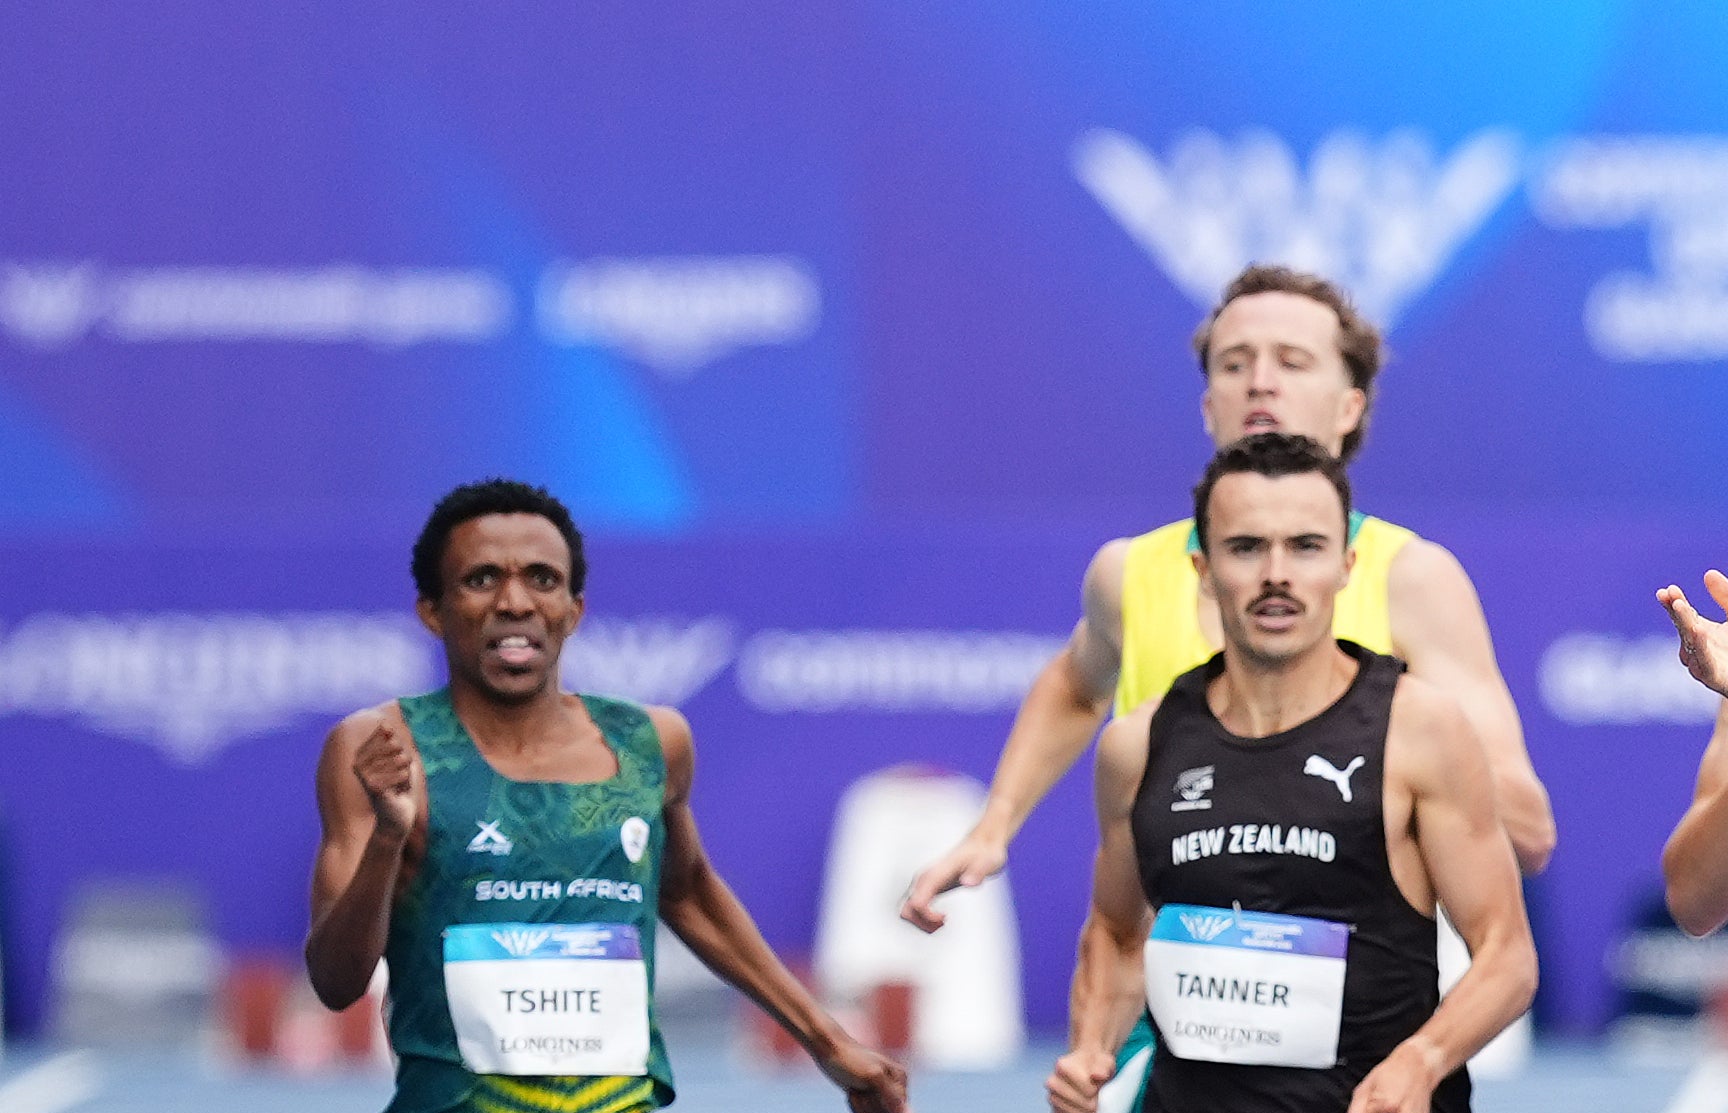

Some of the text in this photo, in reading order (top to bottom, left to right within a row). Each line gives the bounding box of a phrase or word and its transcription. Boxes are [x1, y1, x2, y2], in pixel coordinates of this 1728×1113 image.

[1172, 823, 1337, 865] NEW ZEALAND
[475, 877, 644, 903] SOUTH AFRICA
[501, 989, 602, 1013] TSHITE
[1176, 972, 1290, 1008] TANNER
[500, 1035, 603, 1053] LONGINES
